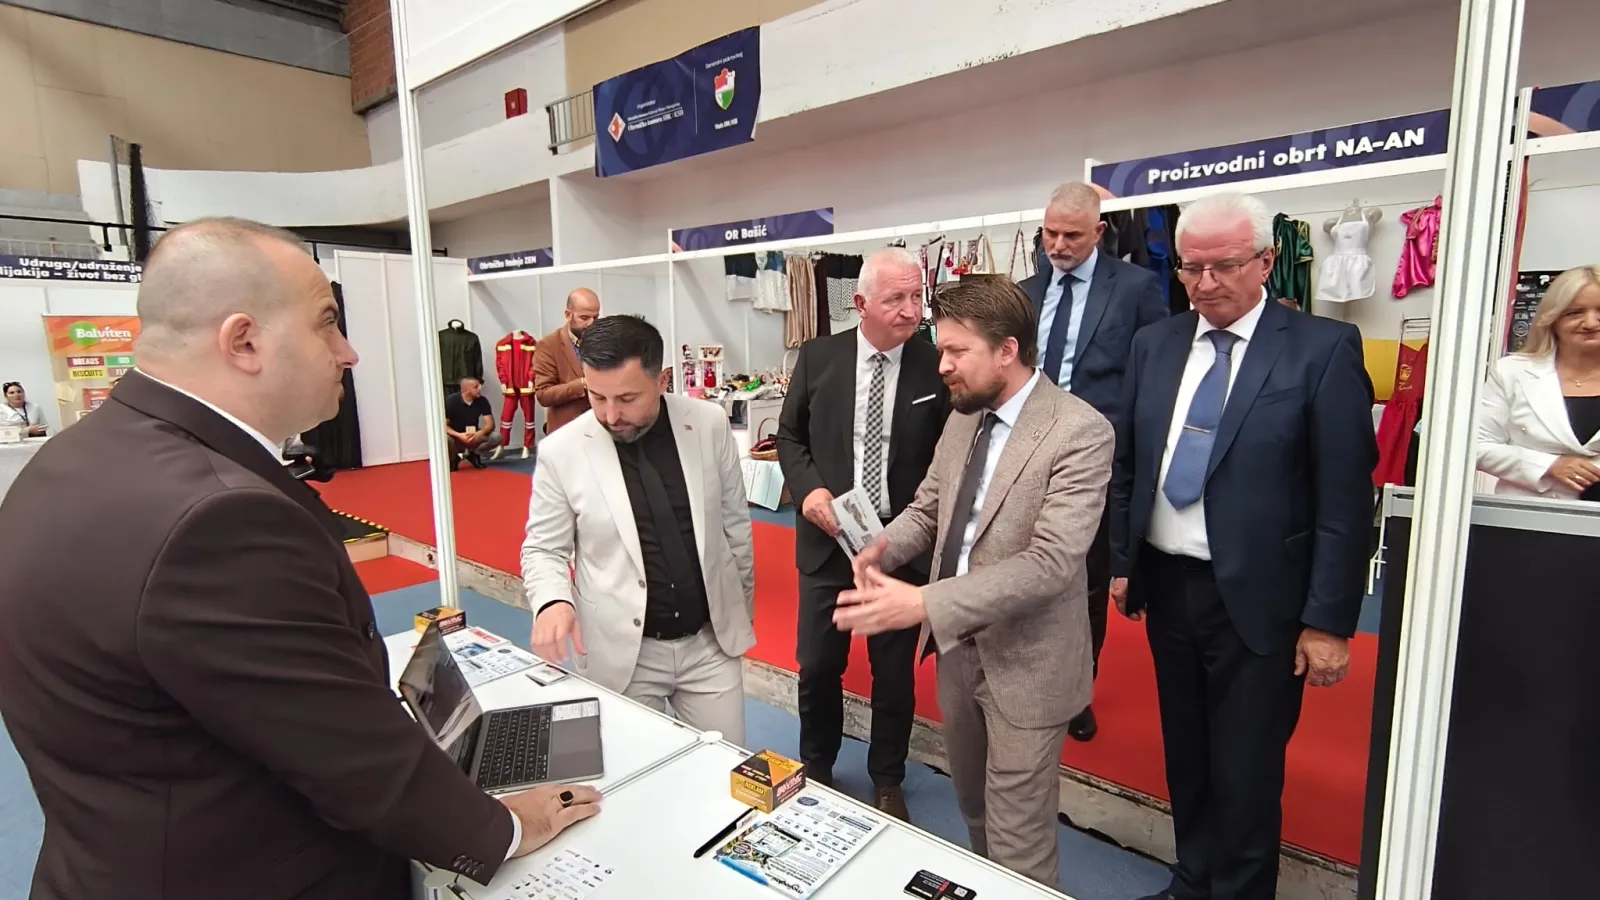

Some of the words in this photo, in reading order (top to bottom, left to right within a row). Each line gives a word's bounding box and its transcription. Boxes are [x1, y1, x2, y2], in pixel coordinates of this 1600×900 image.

[1148, 150, 1265, 184] Proizvodni
[1273, 144, 1327, 166] obrt
[1335, 127, 1425, 158] NA-AN
[725, 228, 738, 241] OR
[742, 225, 767, 239] Bašić
[19, 257, 142, 274] Udruga/udruženje
[67, 267, 100, 280] život
[103, 271, 126, 281] bez
[75, 326, 132, 339] Balviten
[73, 357, 100, 365] BREADS
[72, 369, 103, 377] BISCUITS
